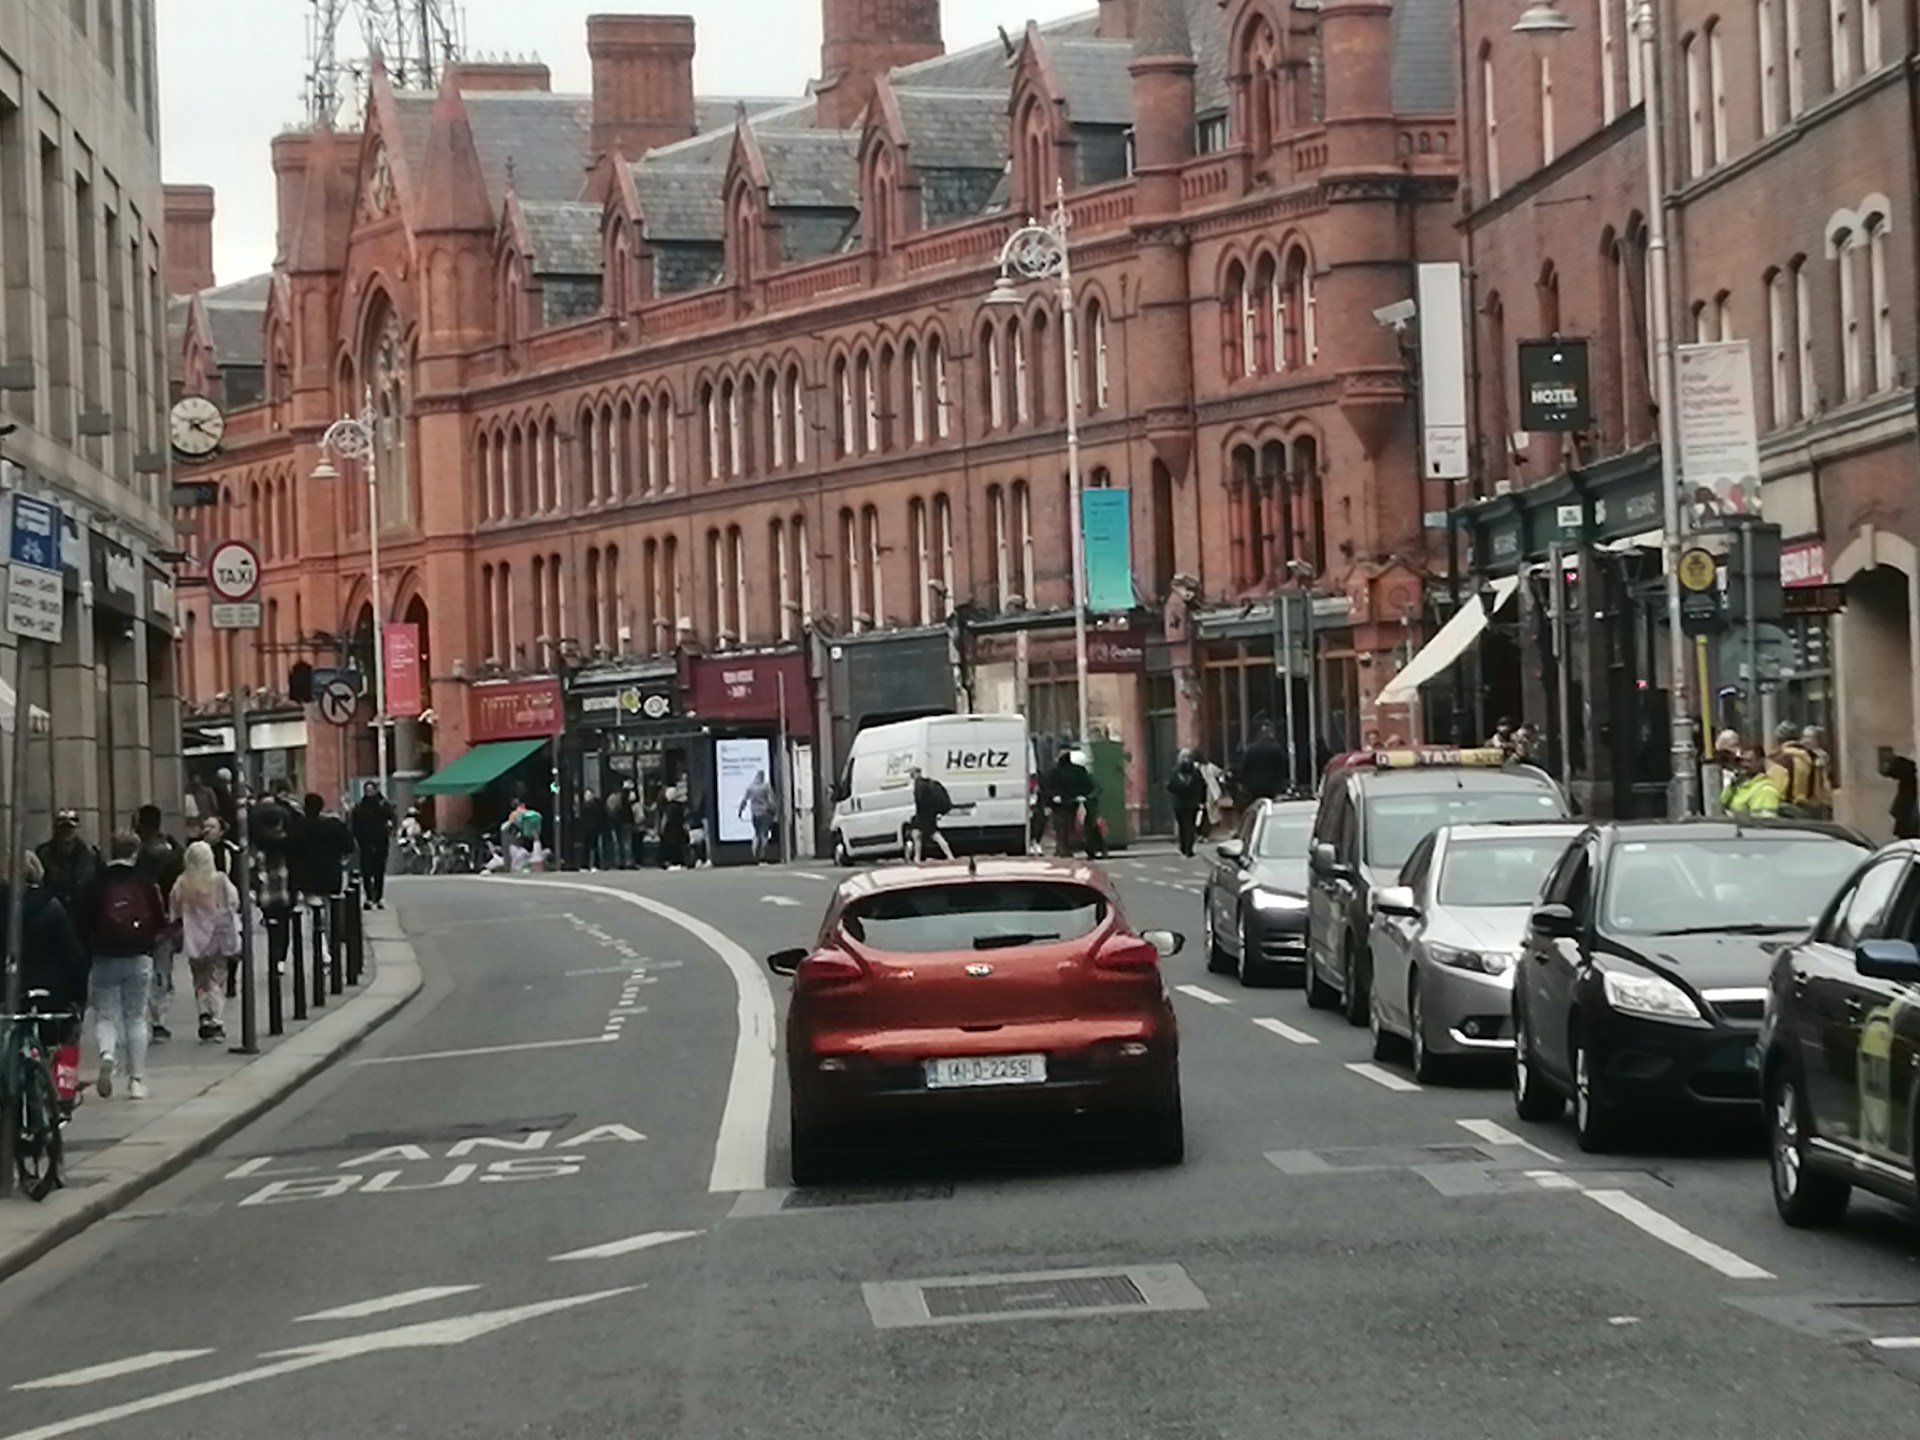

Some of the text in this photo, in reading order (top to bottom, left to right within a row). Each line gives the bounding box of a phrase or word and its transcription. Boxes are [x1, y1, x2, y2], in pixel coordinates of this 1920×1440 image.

[1531, 388, 1578, 404] HOTEL
[217, 568, 253, 585] TAXI
[945, 747, 1010, 770] Hertz
[224, 1123, 648, 1179] LANA
[238, 1155, 587, 1207] BUS
